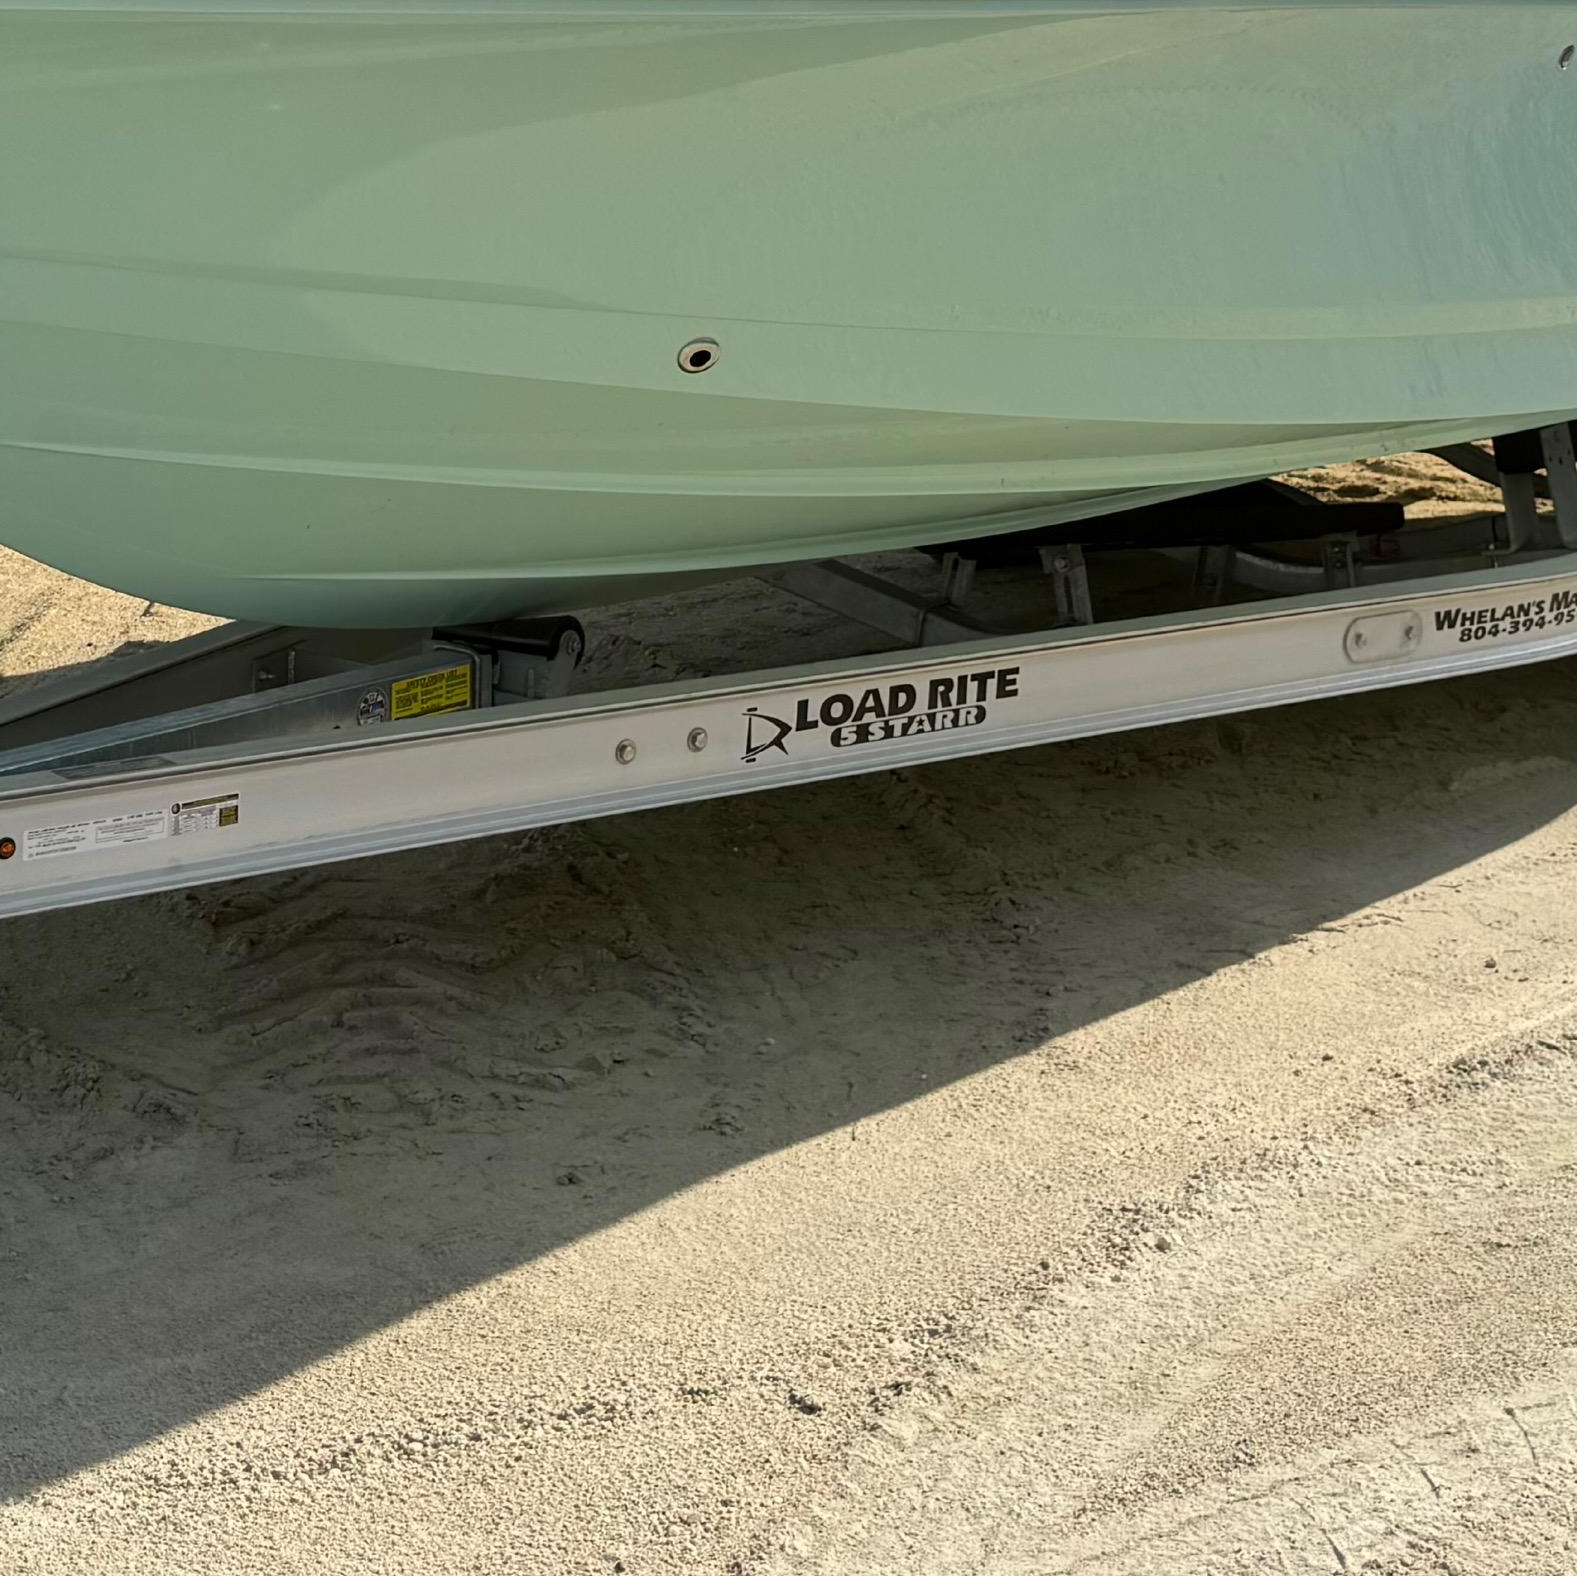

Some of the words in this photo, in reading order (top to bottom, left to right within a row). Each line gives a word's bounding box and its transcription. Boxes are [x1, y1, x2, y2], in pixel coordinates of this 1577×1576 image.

[1434, 599, 1545, 631] WHELAN'S
[795, 683, 917, 732] LOAD
[927, 666, 1020, 710] RITE
[839, 726, 858, 746] 5
[867, 707, 979, 742] STARR
